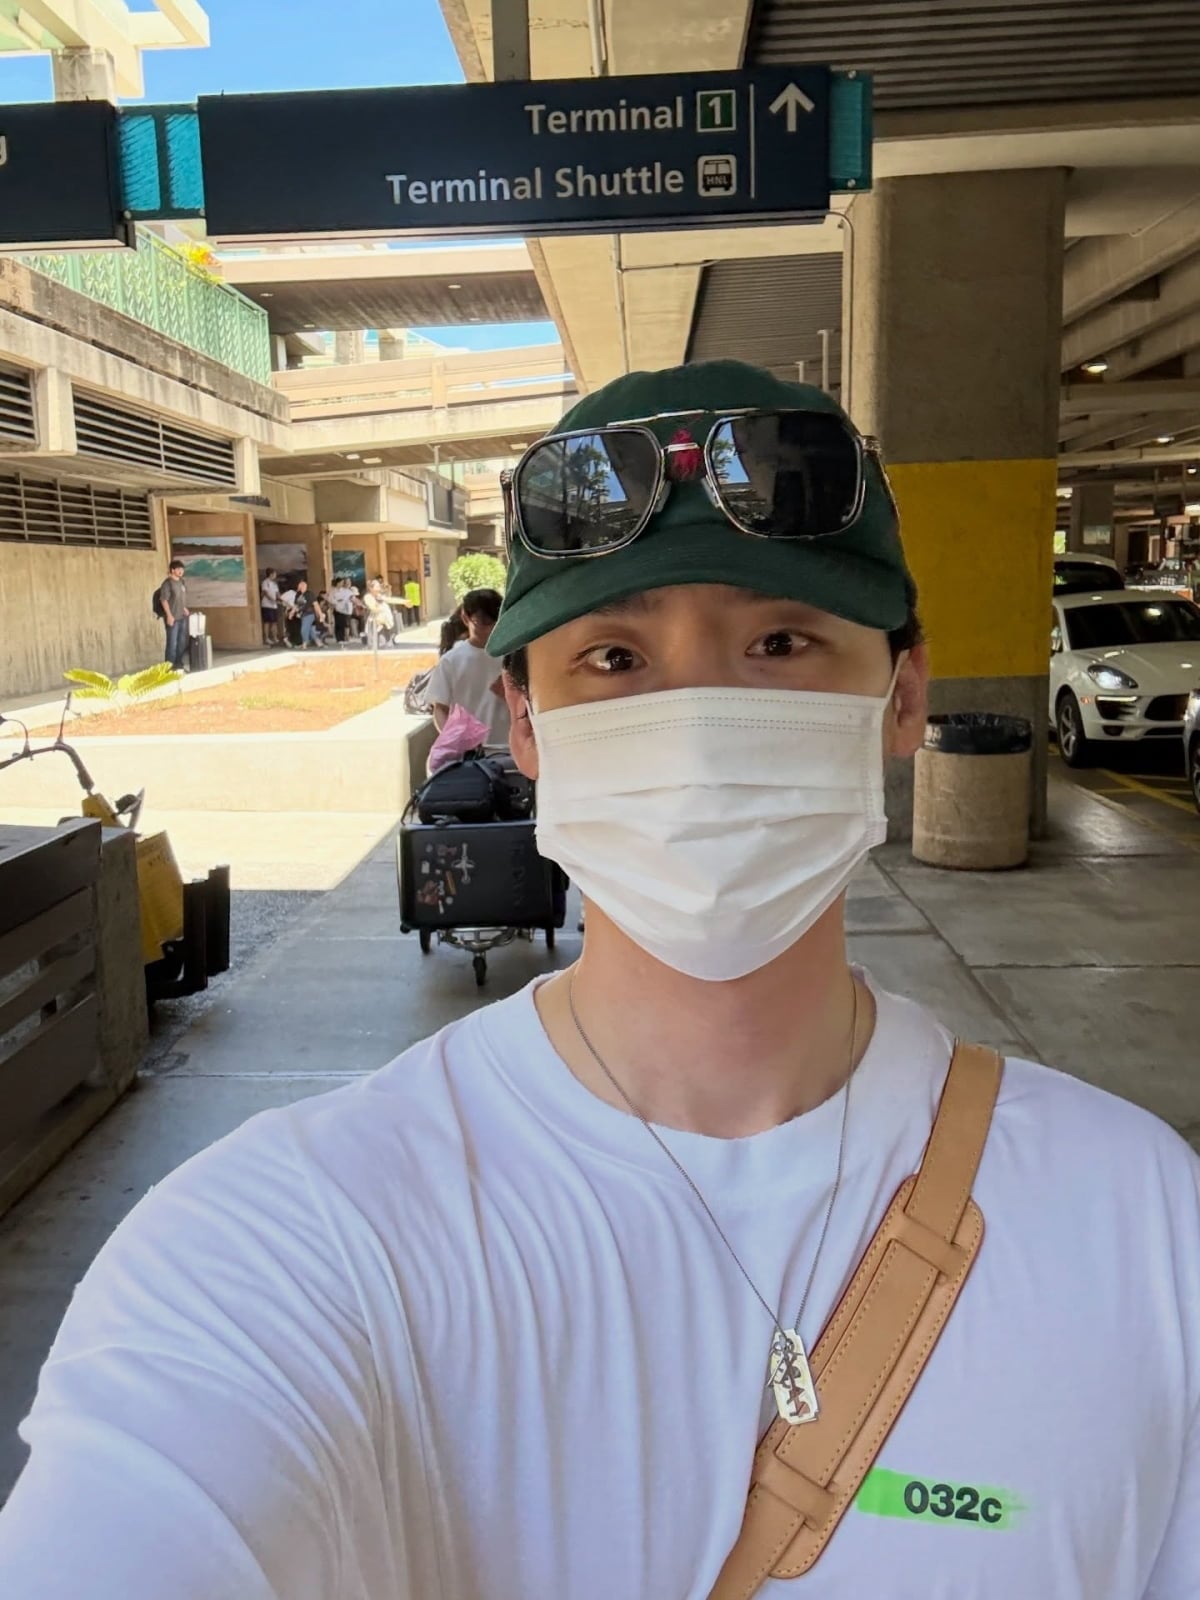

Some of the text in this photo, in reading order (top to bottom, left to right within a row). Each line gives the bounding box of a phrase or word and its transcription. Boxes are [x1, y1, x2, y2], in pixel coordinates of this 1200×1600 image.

[524, 96, 721, 135] Terminal 1
[386, 162, 684, 204] Terminal Shuttle
[706, 175, 729, 185] HNL
[904, 1481, 1002, 1523] 032c
